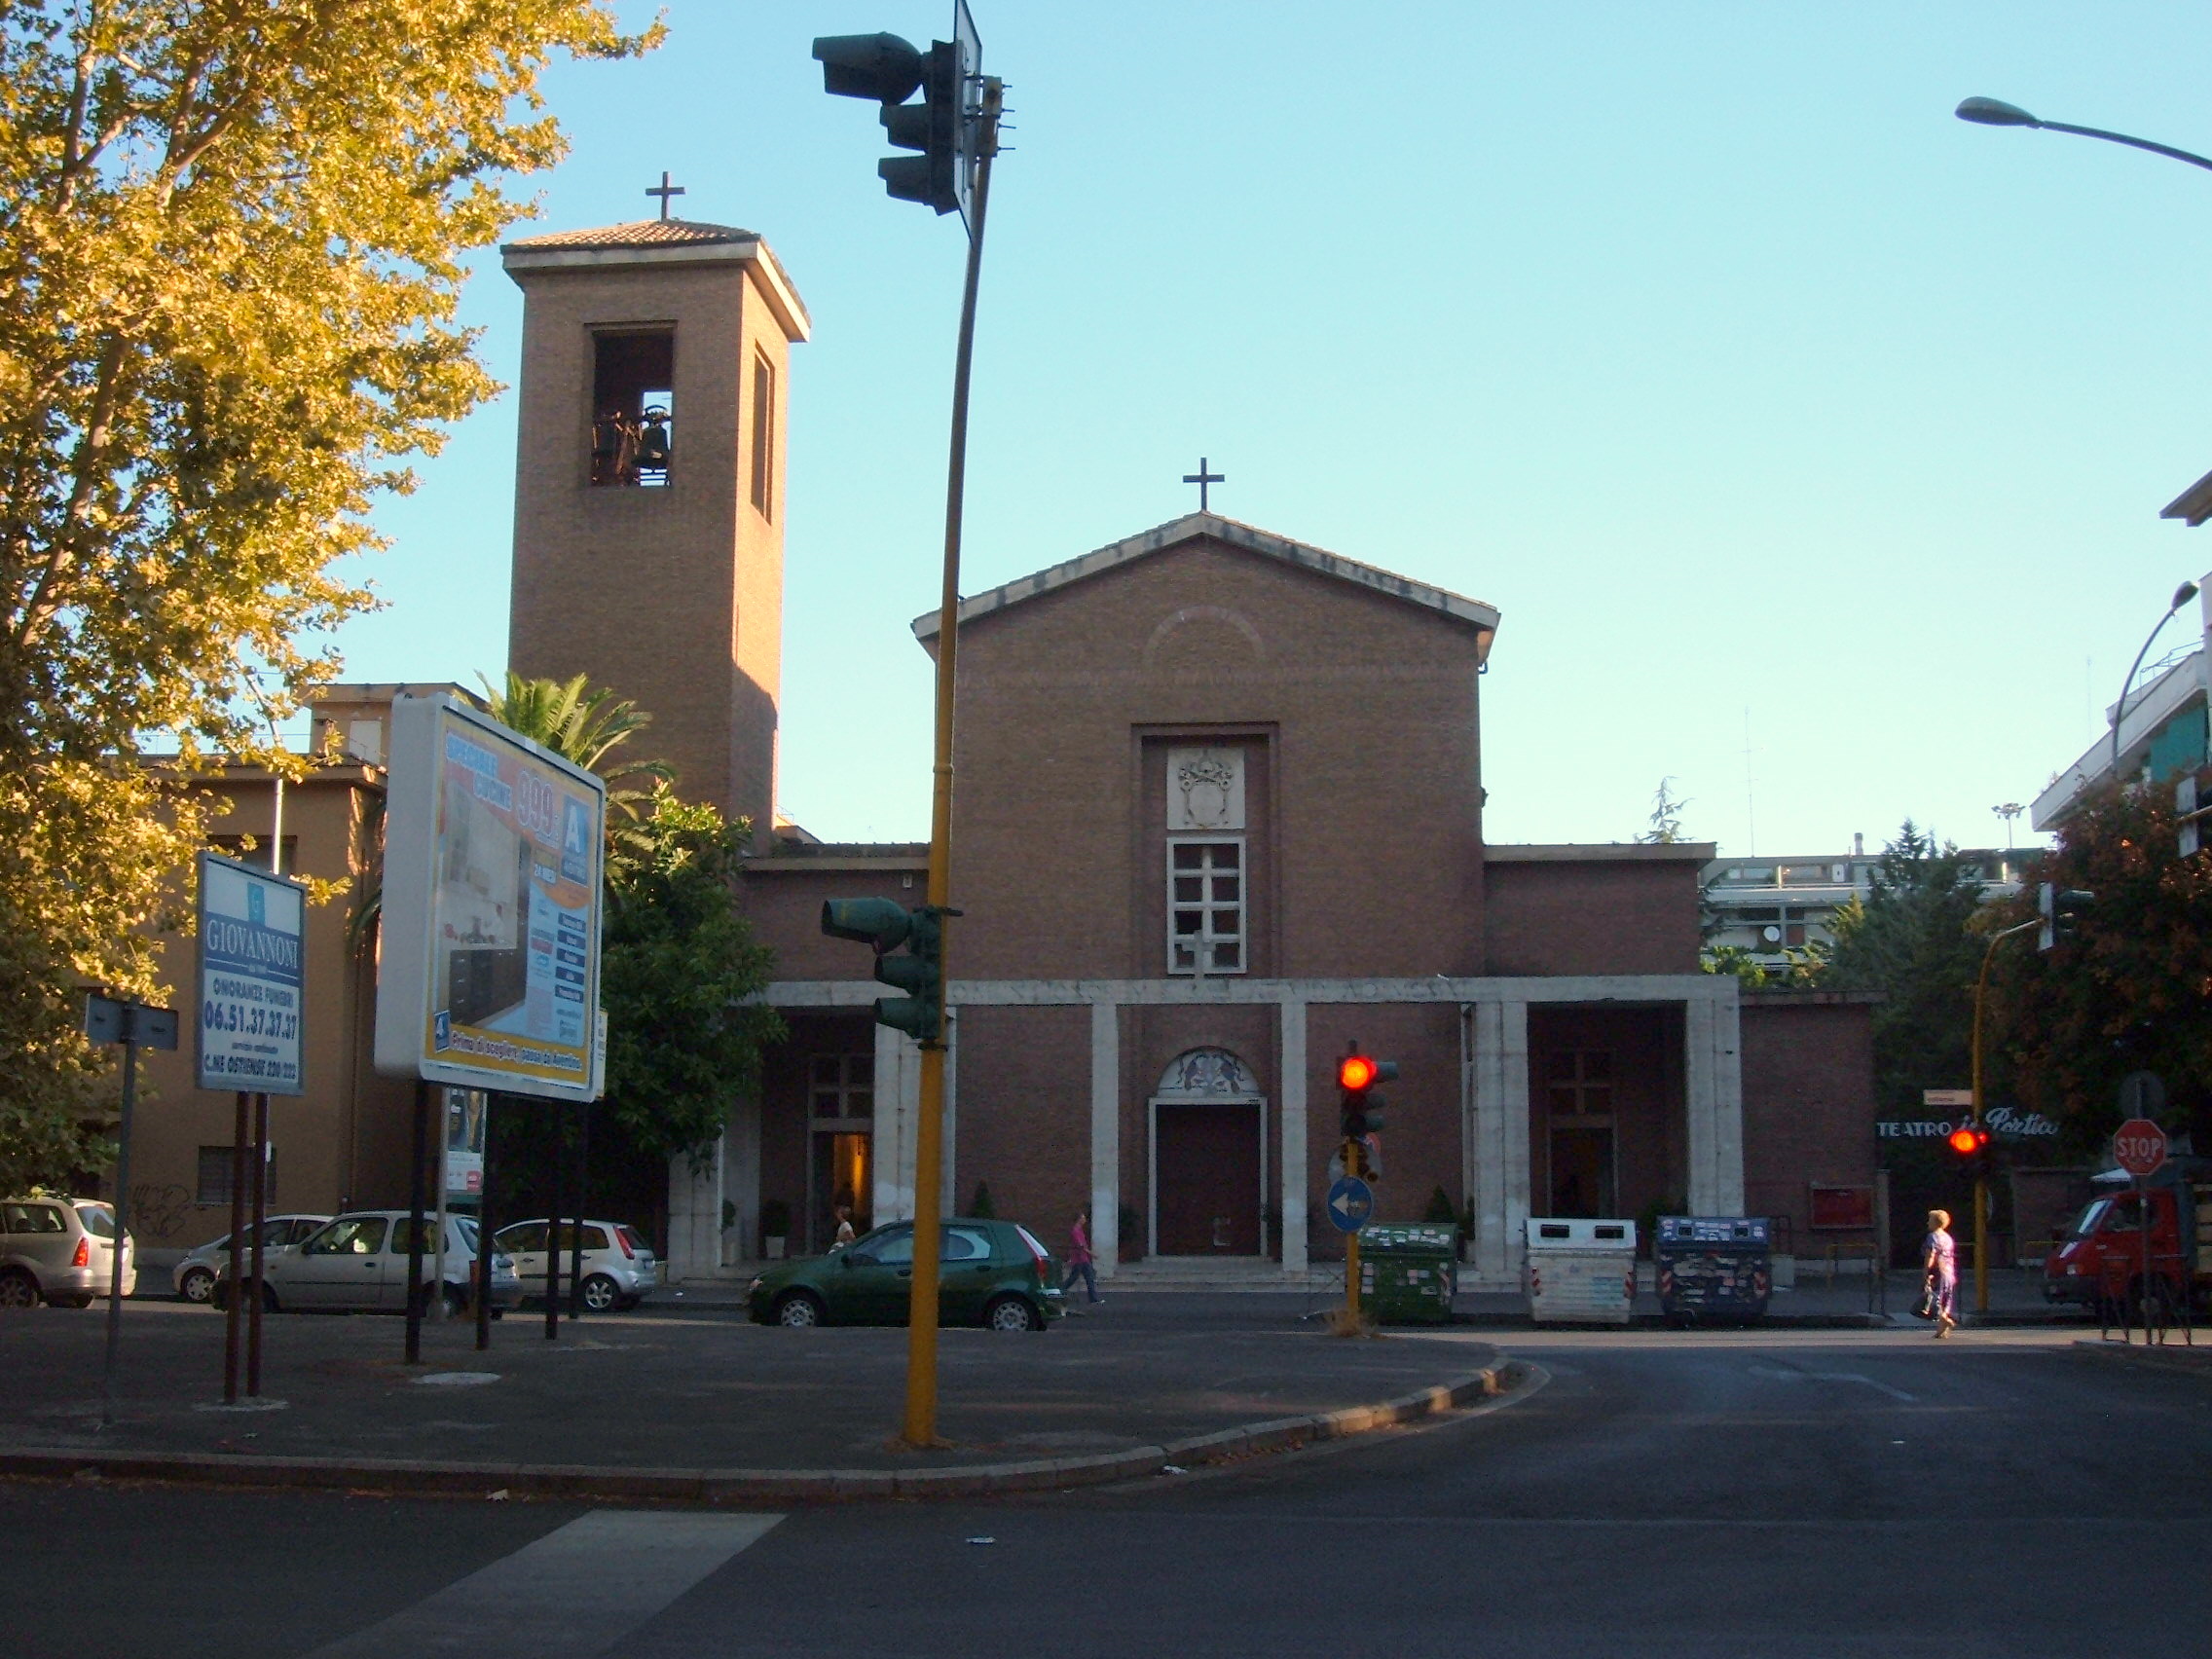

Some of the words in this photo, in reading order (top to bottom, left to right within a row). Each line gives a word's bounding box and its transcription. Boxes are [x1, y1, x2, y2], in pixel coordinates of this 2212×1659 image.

[206, 919, 298, 969] GIOVANNONI
[204, 1000, 297, 1040] 06.51.37.37.37
[1877, 1122, 1953, 1137] TEATRO
[2117, 1136, 2162, 1158] STOP
